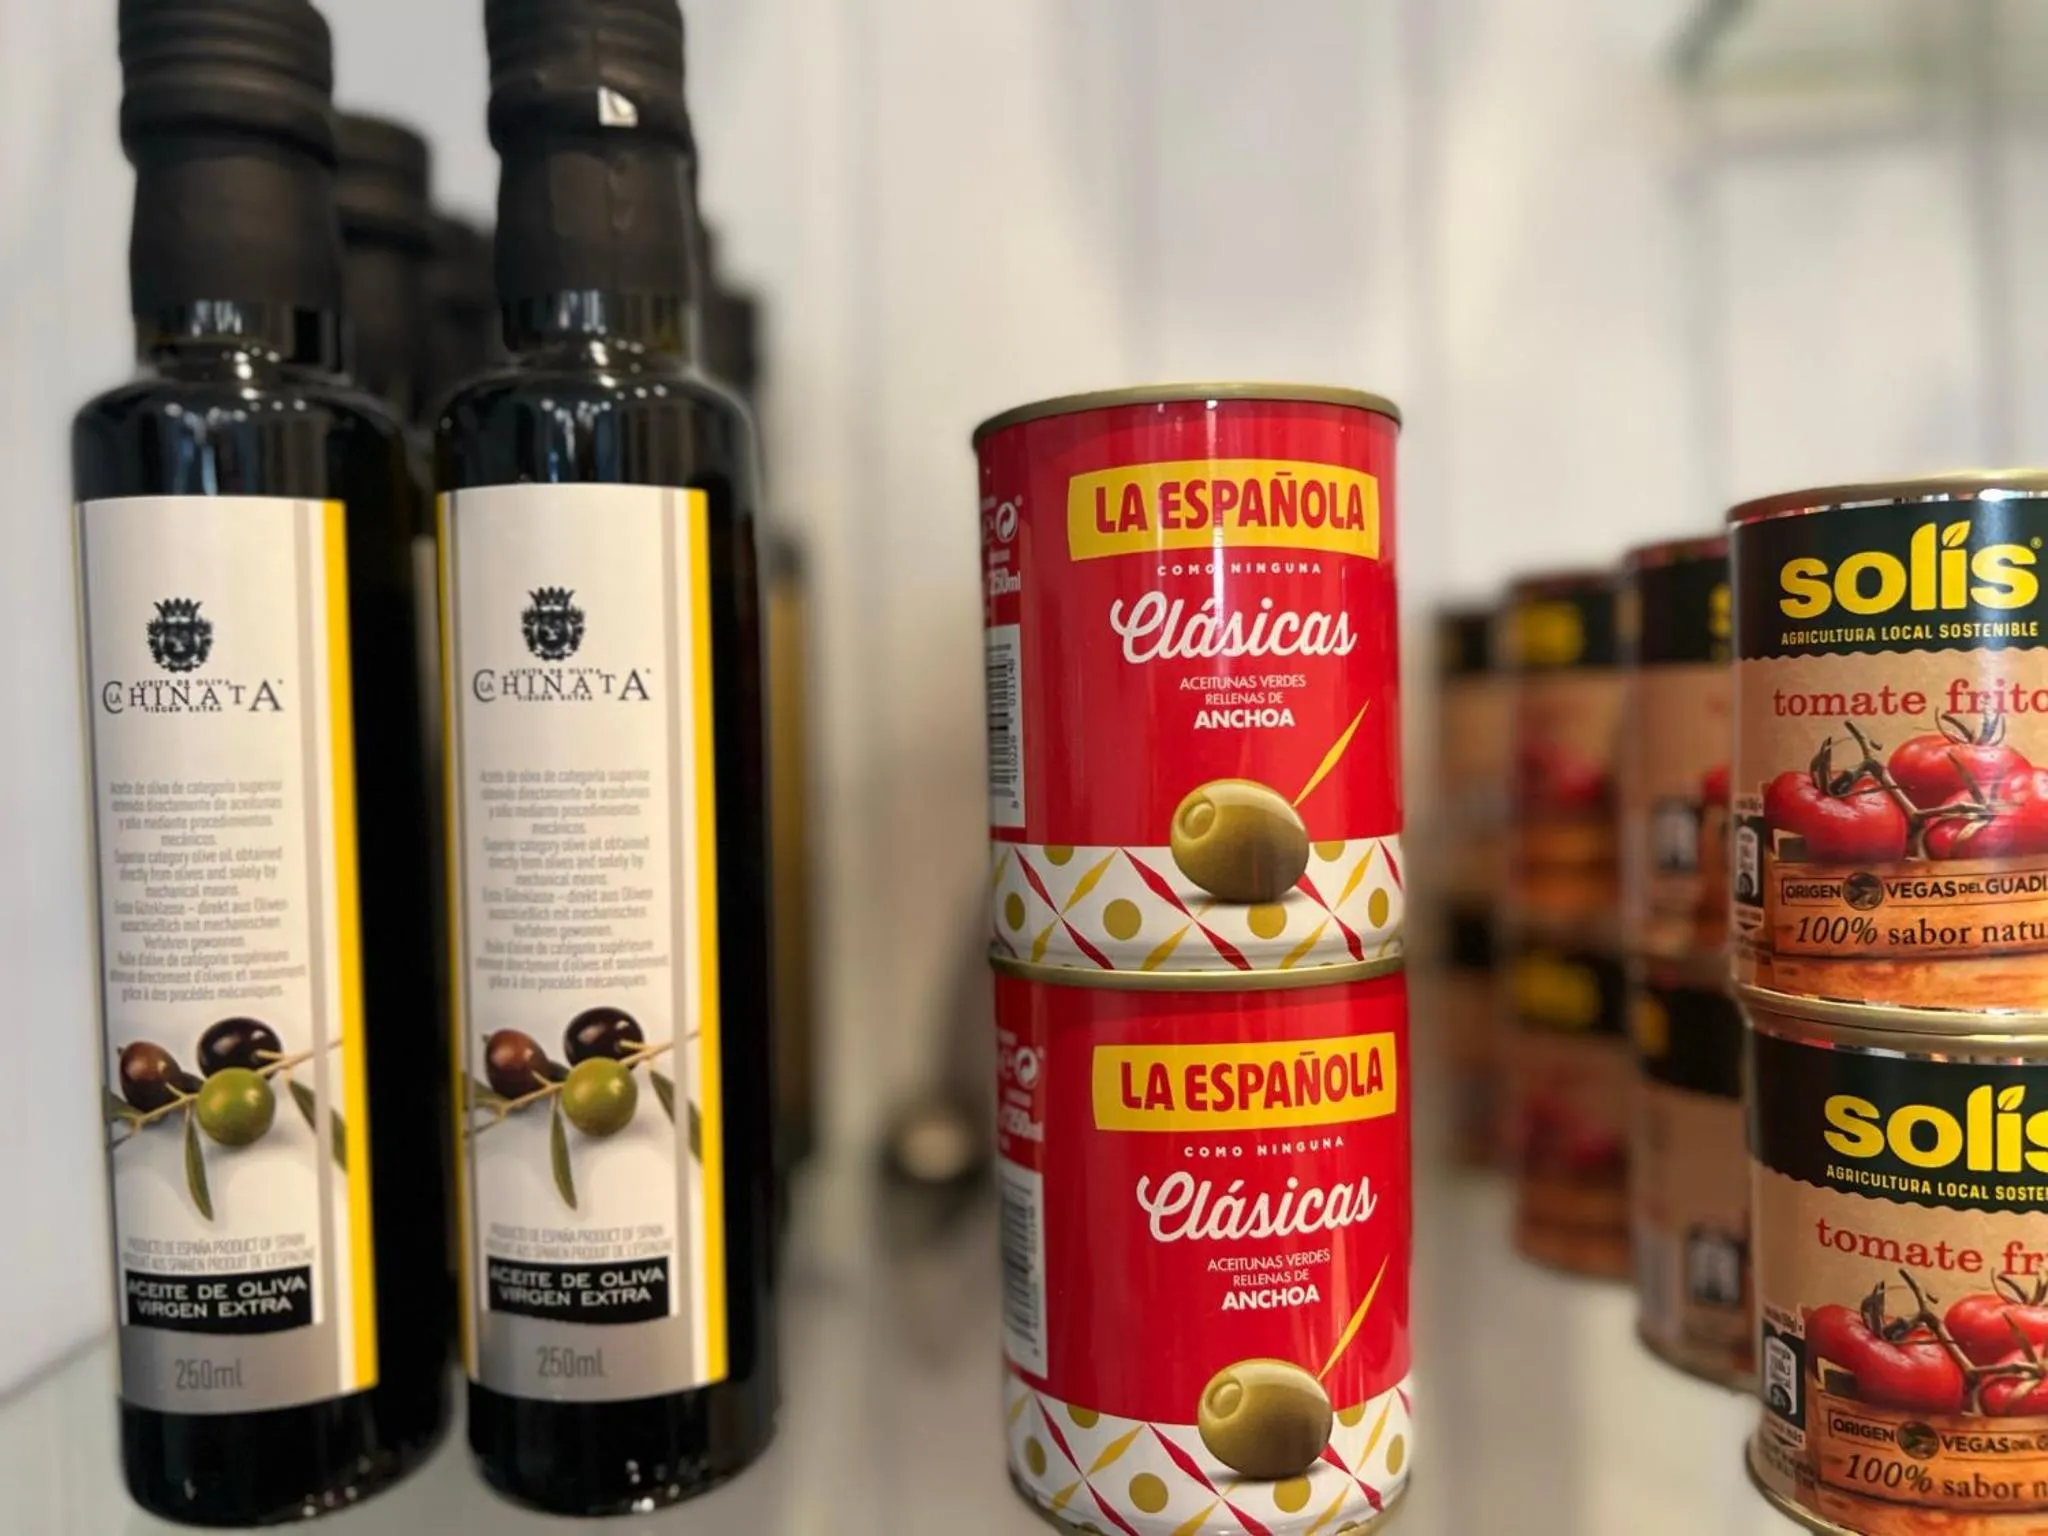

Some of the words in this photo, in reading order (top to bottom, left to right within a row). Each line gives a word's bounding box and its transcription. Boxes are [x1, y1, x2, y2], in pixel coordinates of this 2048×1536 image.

[1094, 483, 1149, 534] LA
[1159, 471, 1365, 532] ESPAÑOLA
[1157, 564, 1214, 577] COMO
[1231, 562, 1322, 575] NINGUNA
[1110, 590, 1358, 664] Clásicas
[1781, 628, 1876, 646] AGRICULTURA
[1881, 625, 1933, 642] LOCAL
[1939, 621, 2039, 639] SOSTENIBLE
[1179, 676, 1257, 690] ACEITUNAS
[1260, 674, 1306, 688] VERDES
[1205, 692, 1265, 705] RELLENAS
[1268, 691, 1284, 704] DE
[1773, 685, 1927, 717] tomate
[1193, 709, 1295, 730] ANCHOA
[1786, 884, 1841, 899] ORIGEN
[1886, 881, 1957, 899] VEGAS
[1958, 883, 1984, 894] DEL
[1796, 916, 1877, 945] 100%
[1888, 918, 1971, 945] sabor
[1120, 1061, 1175, 1111] LA
[1184, 1047, 1383, 1112] ESPAÑOLA
[1184, 1146, 1243, 1158] COMO
[1257, 1136, 1344, 1156] NINGUNA
[1826, 1164, 1932, 1195] AGRICULTURA
[1938, 1182, 1989, 1200] LOCAL
[1995, 1185, 2048, 1202] SOSTE
[1136, 1171, 1378, 1243] Clásicas
[1816, 1217, 1983, 1274] tomate
[1207, 1255, 1283, 1272] ACEITUNAS
[1286, 1249, 1330, 1266] VERDES
[198, 1284, 229, 1299] DE
[238, 1276, 307, 1298] OLIVA
[561, 1273, 591, 1288] DE
[600, 1266, 665, 1288] OLIVA
[1233, 1272, 1292, 1286] RELLENAS
[1295, 1268, 1310, 1282] DE
[138, 1302, 208, 1318] VIRGEN
[218, 1297, 293, 1318] EXTRA
[500, 1288, 571, 1306] VIRGEN
[581, 1287, 652, 1306] EXTRA
[1221, 1286, 1320, 1311] ANCHOA
[175, 1358, 244, 1390] 250ml
[537, 1346, 608, 1377] 250ml
[1832, 1417, 1895, 1443] ORIGEN
[1940, 1434, 2010, 1453] VEGAS
[1846, 1453, 1932, 1493] 100%
[1943, 1473, 2025, 1499] sabor
